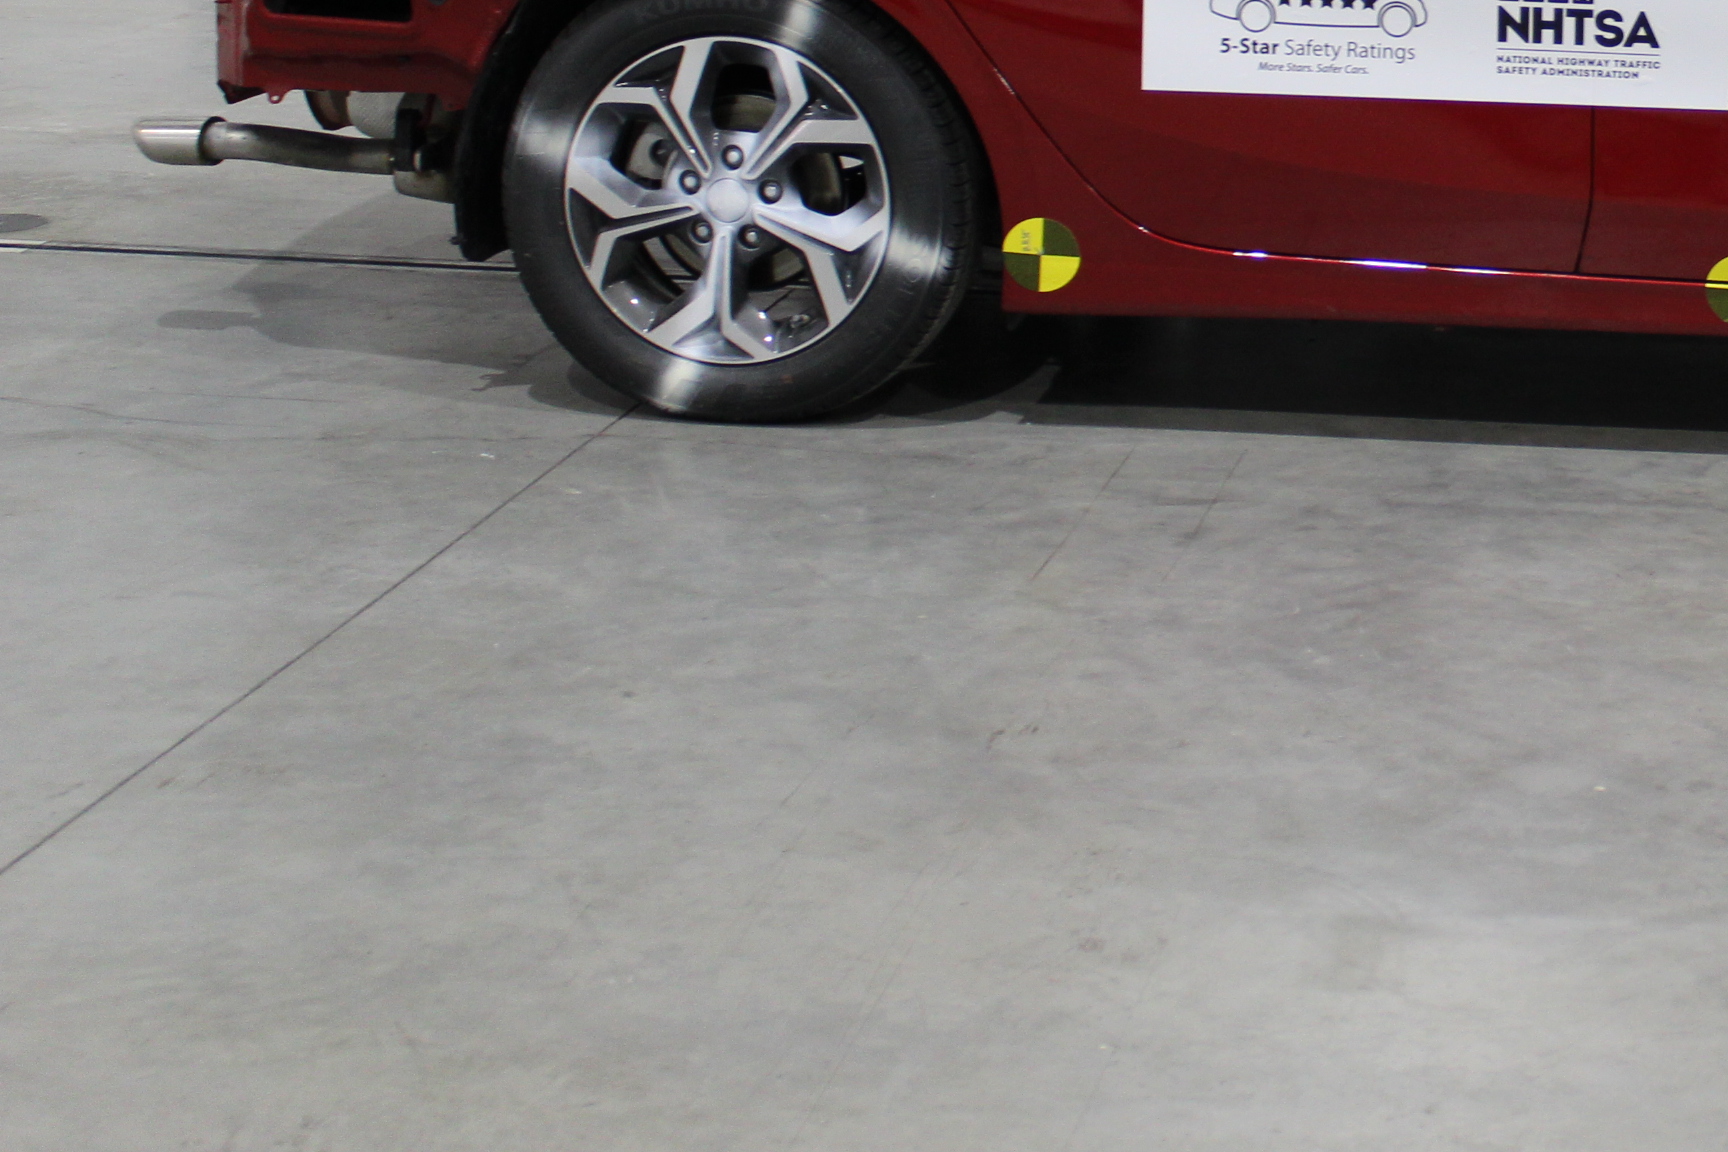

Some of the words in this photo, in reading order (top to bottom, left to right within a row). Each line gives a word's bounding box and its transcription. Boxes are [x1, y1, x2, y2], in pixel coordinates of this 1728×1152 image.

[1497, 5, 1661, 49] NHTSA
[1219, 37, 1279, 55] 5-Star
[1284, 39, 1342, 61] Safety
[1346, 41, 1416, 64] Ratings
[1257, 61, 1285, 72] More
[1286, 62, 1314, 73] Stars.
[1316, 63, 1342, 74] Safer
[1344, 64, 1369, 75] Cars.
[1496, 55, 1553, 65] NATIONAL
[1557, 57, 1610, 67] HIGHWAY
[1614, 59, 1661, 69] TRAFFIC
[1496, 66, 1537, 75] SAFETY
[1541, 67, 1640, 79] ADMINISTRATION
